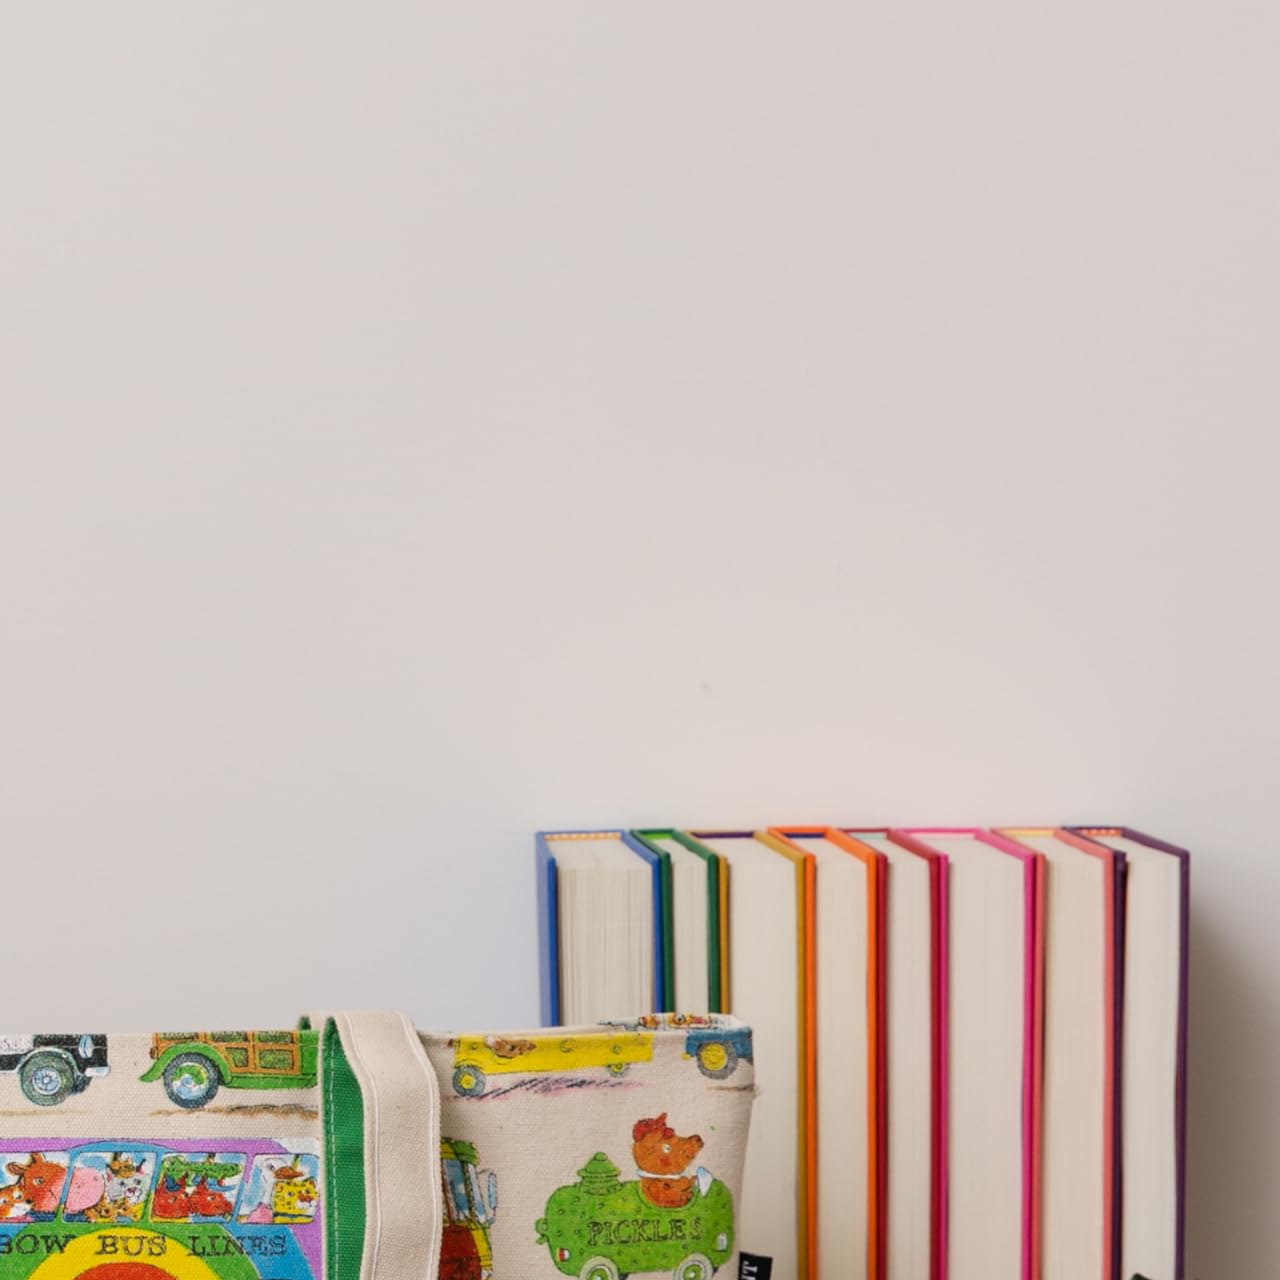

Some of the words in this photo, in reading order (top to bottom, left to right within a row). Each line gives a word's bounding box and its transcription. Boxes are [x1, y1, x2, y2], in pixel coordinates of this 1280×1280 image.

[587, 1216, 702, 1246] PICKLES
[94, 1234, 167, 1256] BUS
[186, 1234, 287, 1256] LINES
